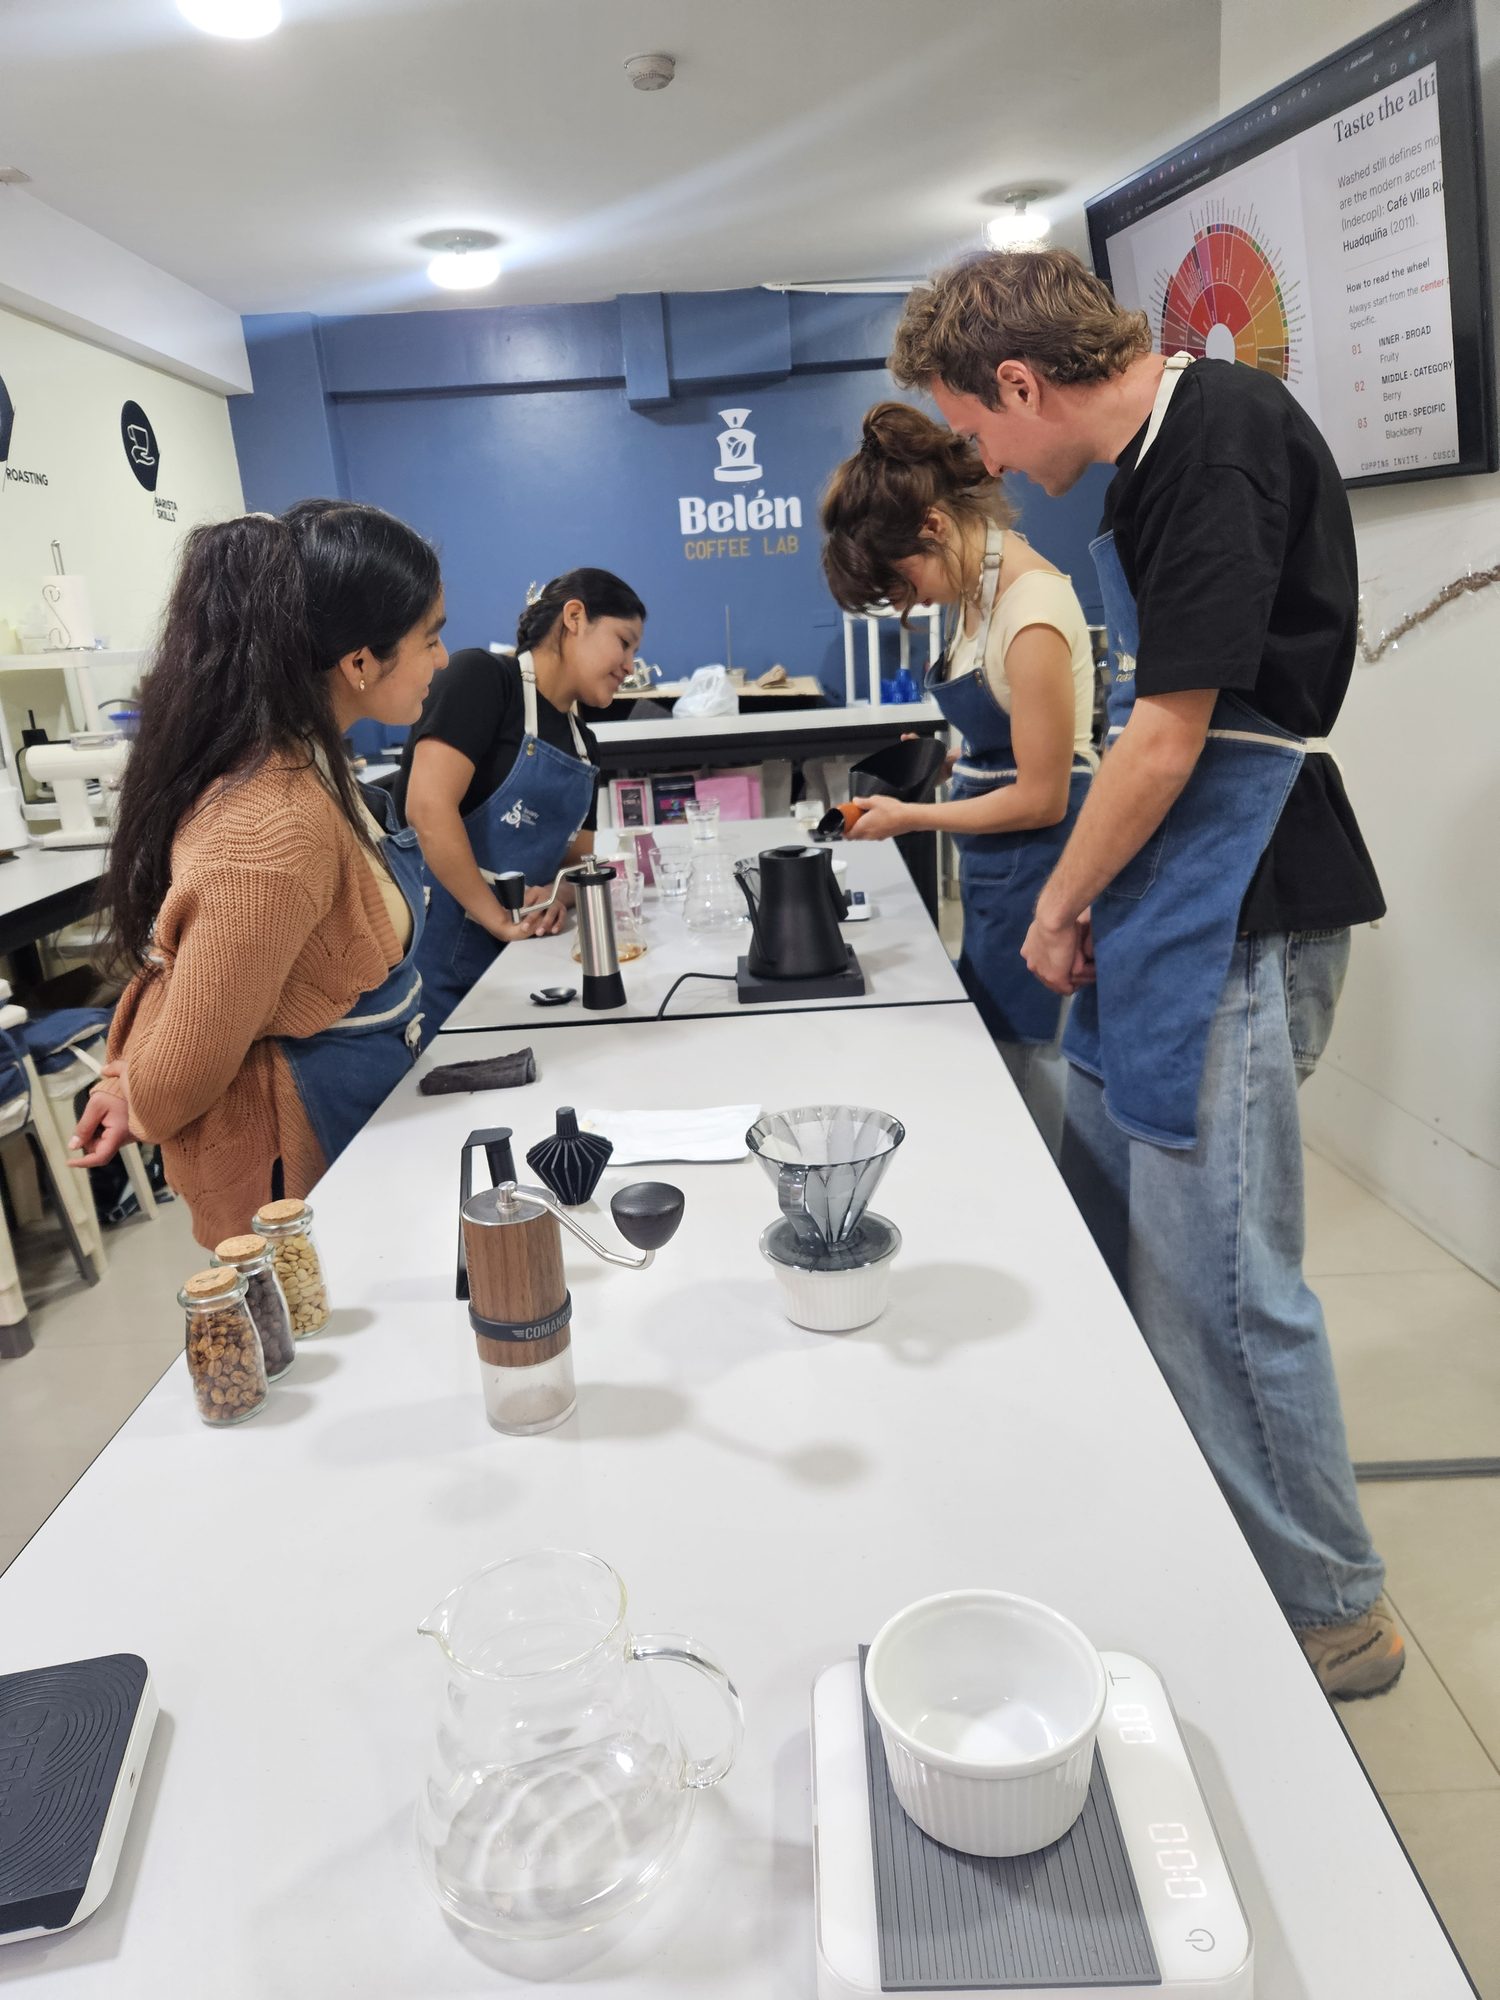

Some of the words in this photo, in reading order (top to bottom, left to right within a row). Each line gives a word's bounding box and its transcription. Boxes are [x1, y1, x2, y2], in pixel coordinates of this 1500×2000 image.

[1333, 111, 1375, 143] Taste
[1378, 95, 1404, 121] the
[1338, 166, 1371, 188] Washed
[1372, 158, 1387, 174] still
[1389, 142, 1422, 165] defines
[1339, 198, 1353, 210] are
[1354, 190, 1368, 204] the
[1369, 175, 1403, 197] modern
[1405, 159, 1436, 183] accent
[1386, 194, 1408, 212] Café
[1410, 186, 1430, 203] Villa
[1343, 227, 1388, 252] Huadquiña
[1346, 283, 1362, 293] How
[1363, 279, 1371, 288] to
[1373, 272, 1389, 285] read
[1392, 268, 1405, 279] the
[1407, 257, 1430, 273] wheel
[1349, 301, 1371, 314] Always
[1373, 295, 1388, 307] start
[1389, 291, 1406, 302] from
[1407, 286, 1419, 297] the
[1420, 279, 1445, 293] center
[1378, 333, 1400, 347] INNER
[1405, 325, 1431, 340] BROAD
[1380, 352, 1399, 363] Fruity
[1381, 371, 1408, 384] MIDDLE
[1414, 360, 1453, 378] CATEGORY
[1383, 391, 1401, 401] Berry
[1384, 410, 1408, 422] OUTER
[1413, 403, 1446, 417] SPECIFIC
[1386, 427, 1423, 439] Blackberry
[1433, 449, 1456, 460] CUSCO
[6, 468, 48, 486] ROASTING
[154, 497, 178, 511] BARISTA
[157, 509, 176, 522] SKILLS
[678, 489, 803, 535] Belén
[685, 538, 751, 560] COFFEE
[763, 535, 799, 555] LAB
